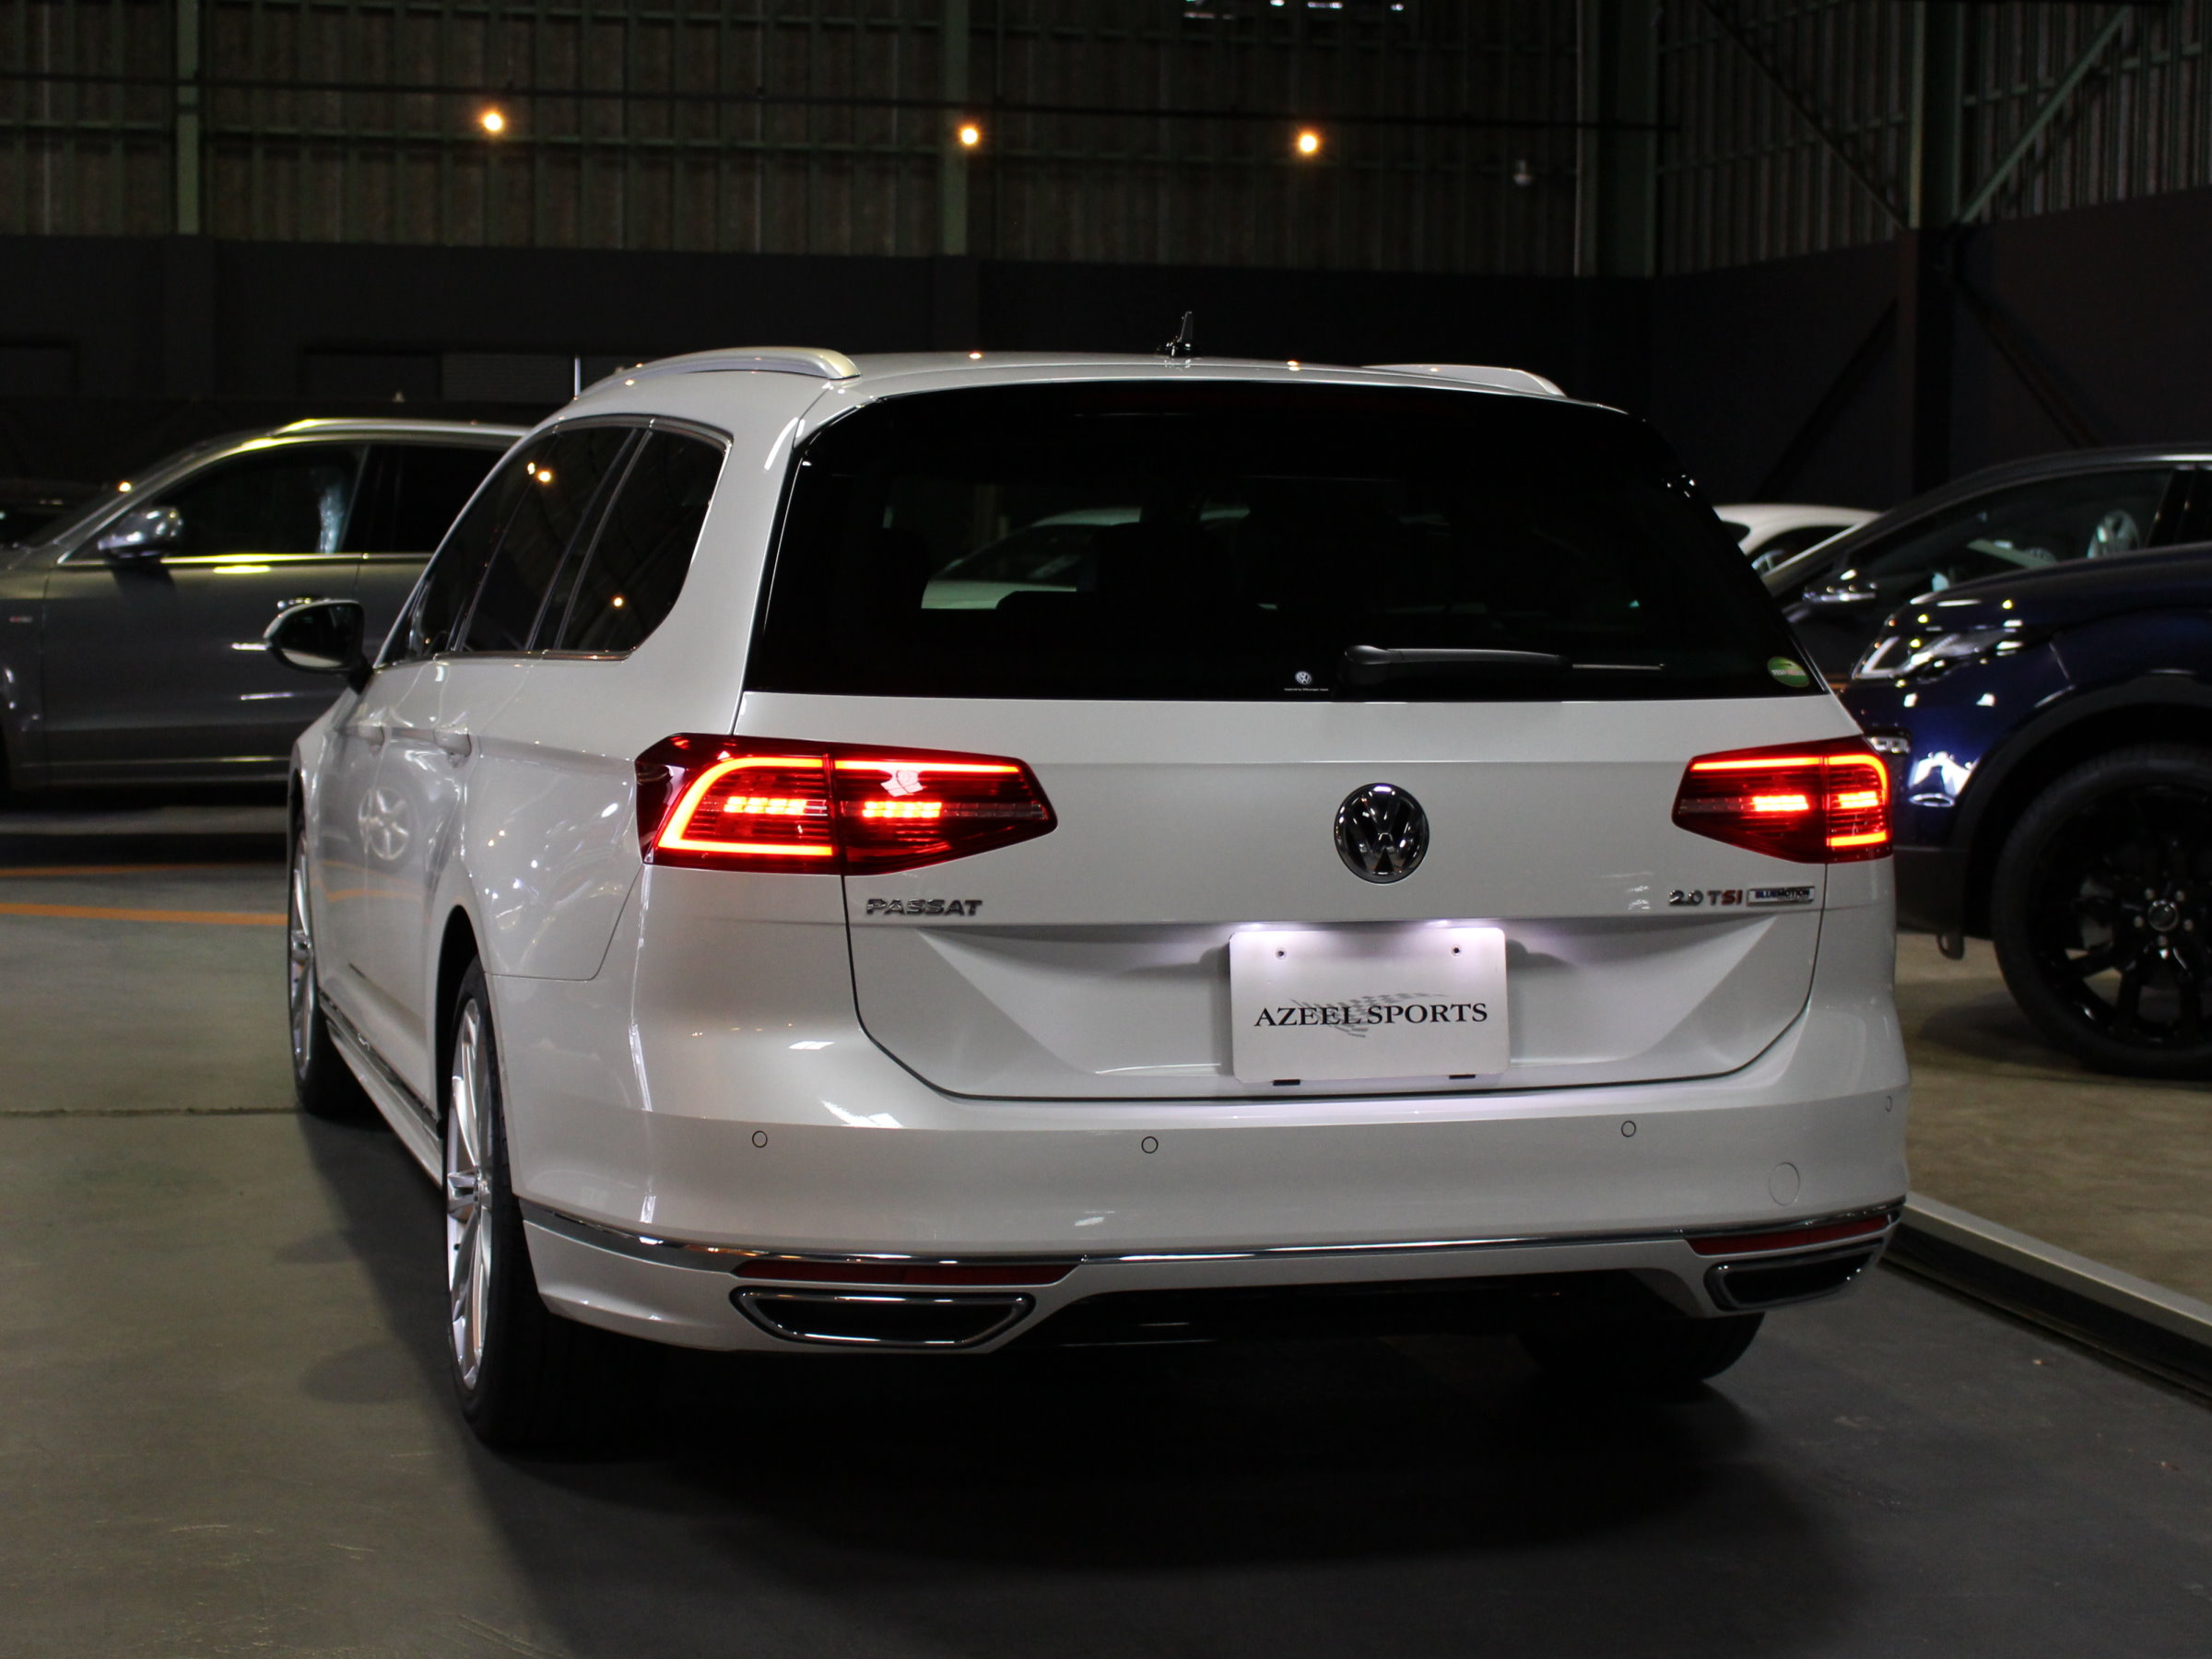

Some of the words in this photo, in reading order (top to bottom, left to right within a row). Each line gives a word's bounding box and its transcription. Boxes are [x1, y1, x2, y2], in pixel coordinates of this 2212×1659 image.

[1707, 888, 1743, 906] TSI
[865, 898, 983, 916] PASSAT
[1253, 1006, 1362, 1027] AZEEL
[1367, 1003, 1488, 1025] SPORTS
